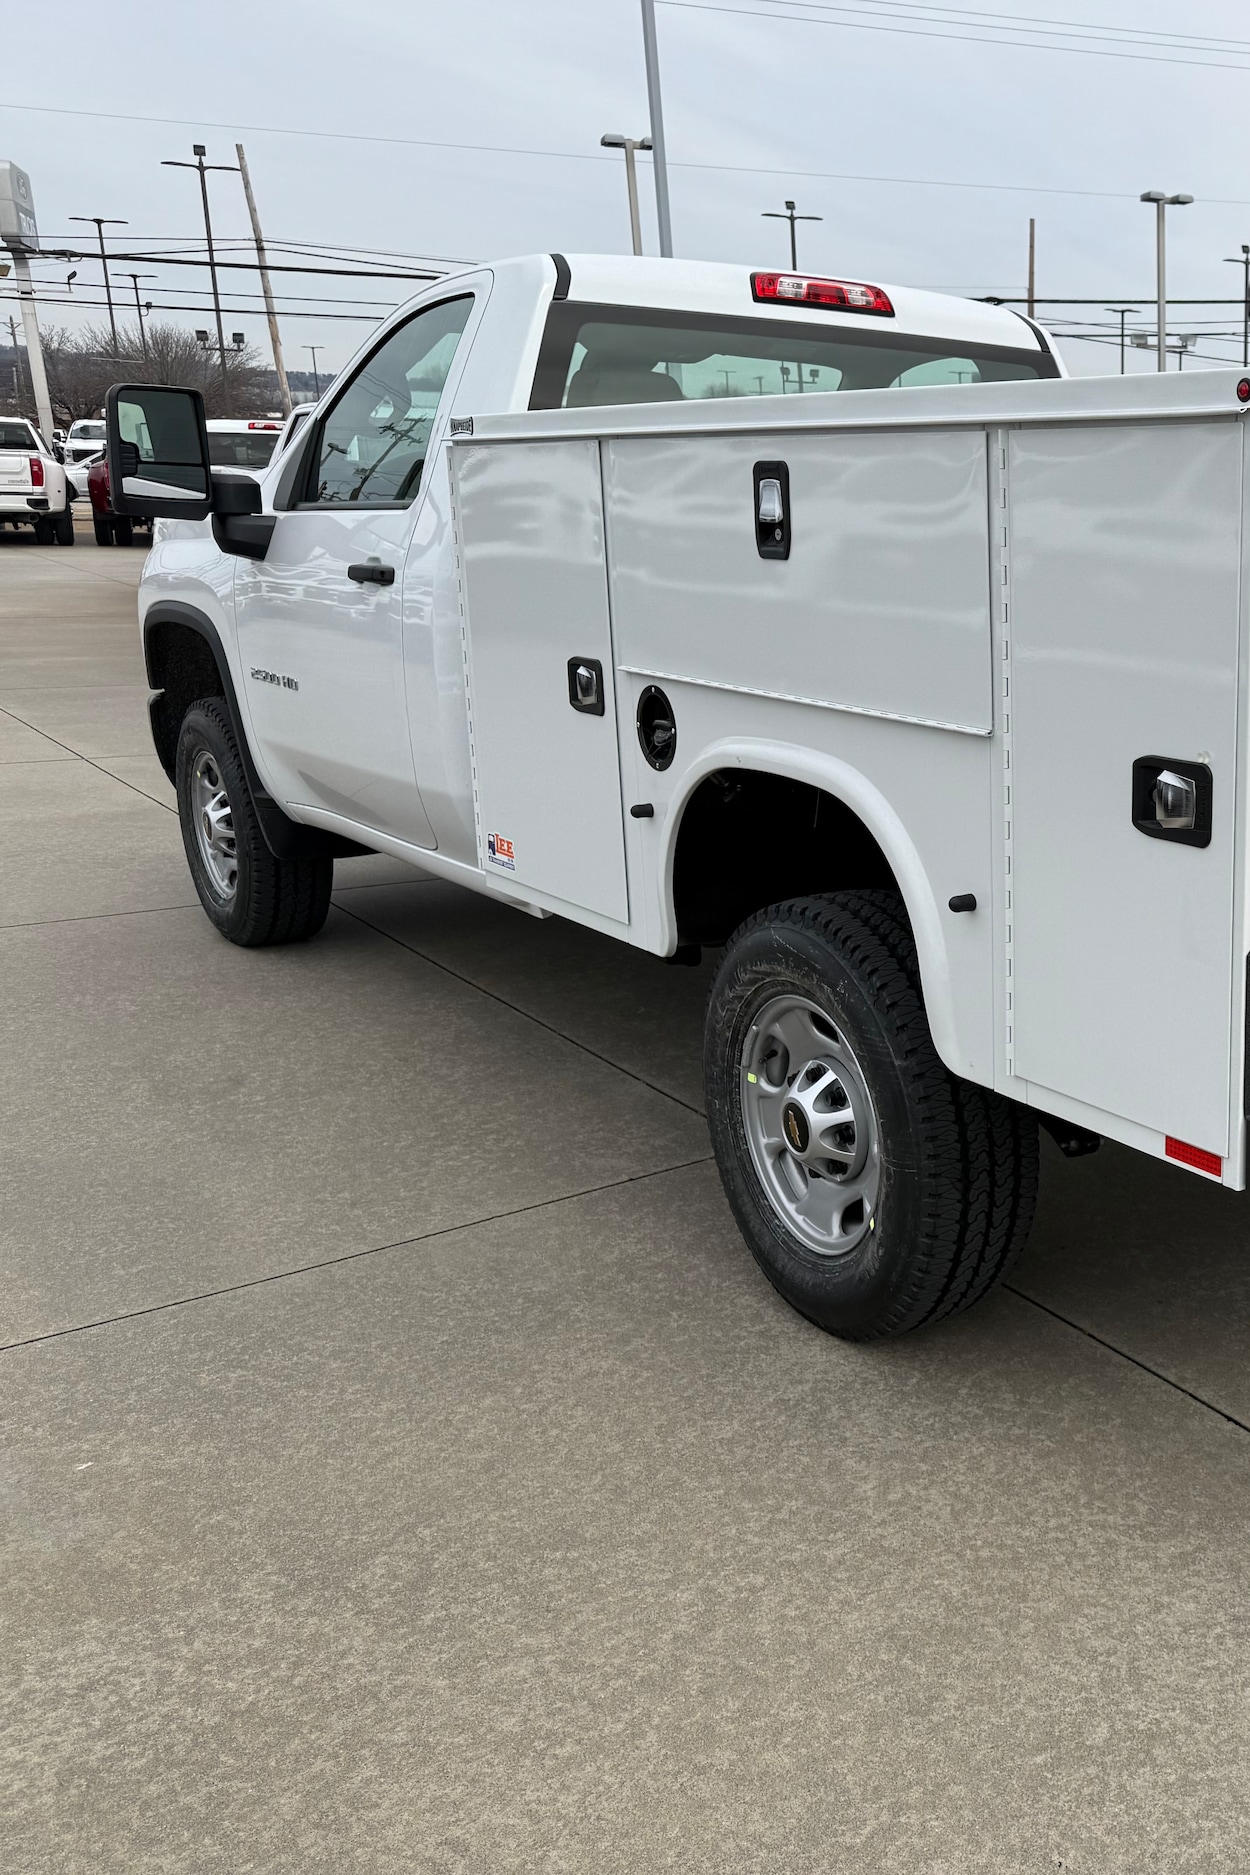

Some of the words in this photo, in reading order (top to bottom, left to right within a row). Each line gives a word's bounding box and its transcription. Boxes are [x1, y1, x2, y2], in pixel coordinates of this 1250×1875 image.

[250, 667, 281, 686] 2500
[282, 675, 299, 691] HD
[494, 833, 515, 859] LEE
